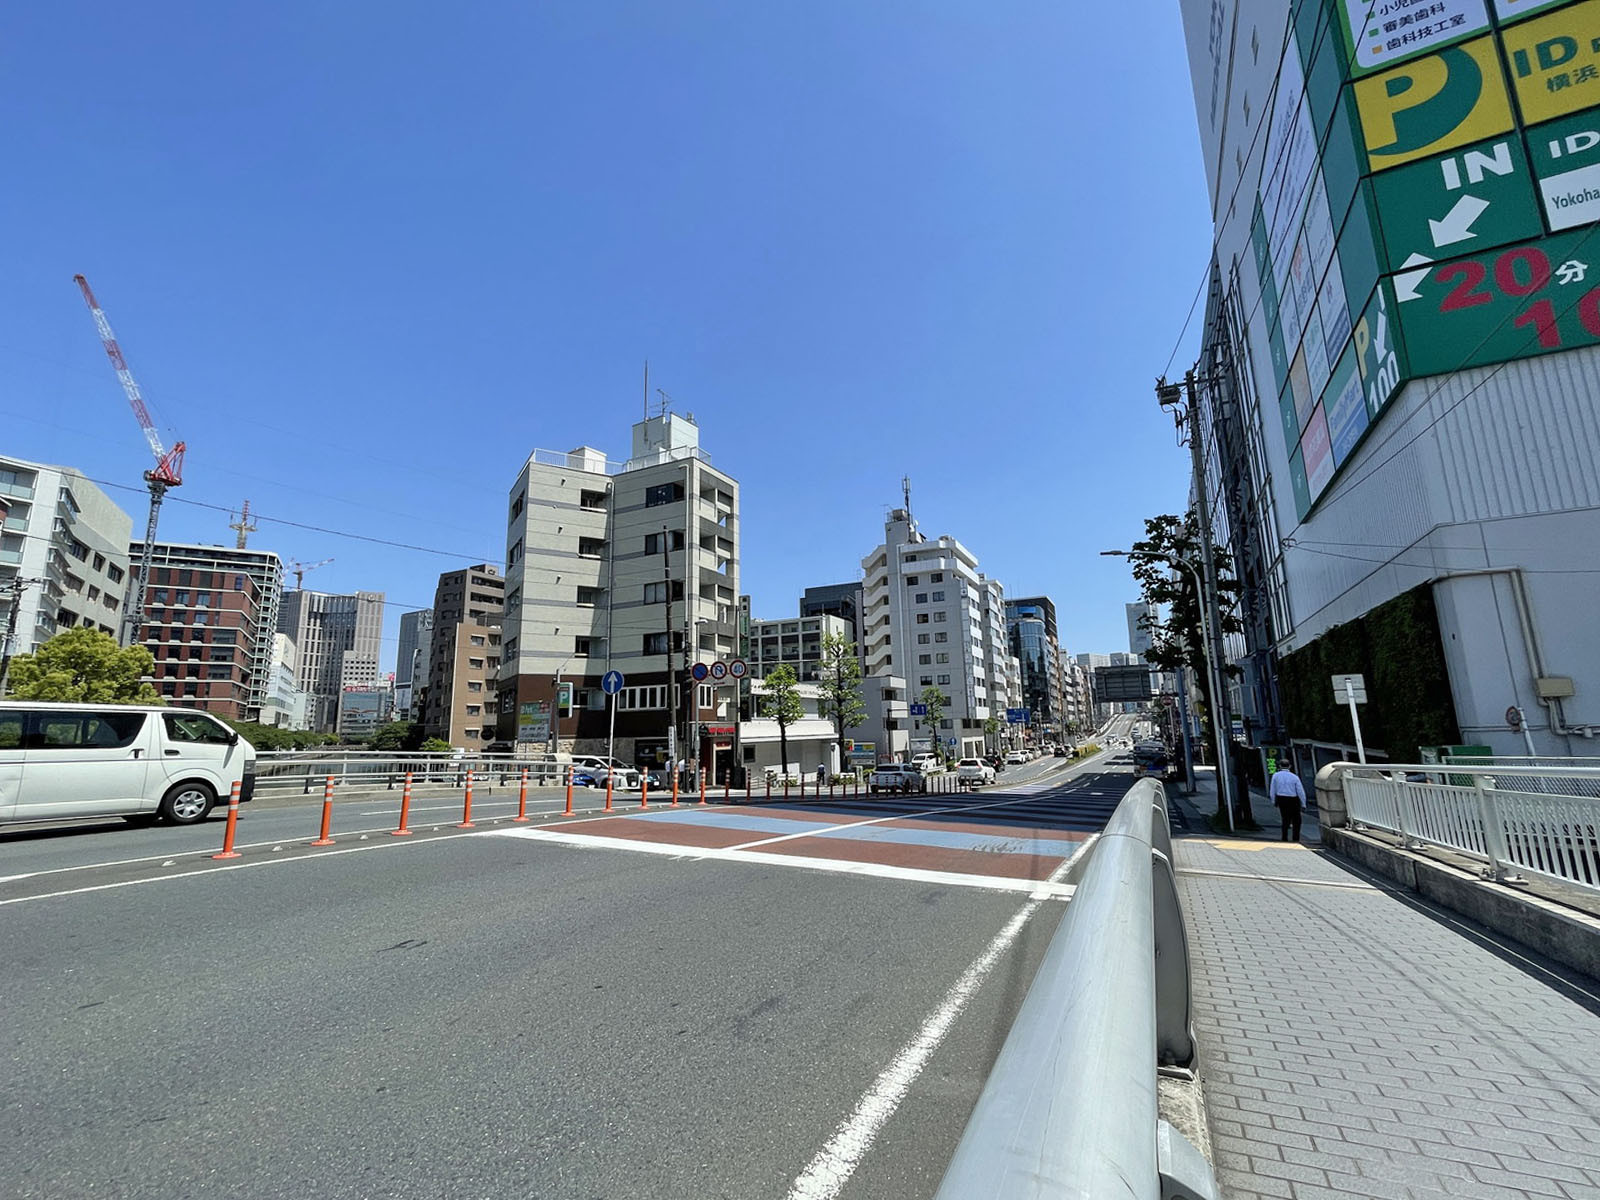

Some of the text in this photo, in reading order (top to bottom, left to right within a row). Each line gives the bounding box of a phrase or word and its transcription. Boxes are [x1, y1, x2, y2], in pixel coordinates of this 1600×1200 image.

[1383, 2, 1446, 33] 審美歯科
[1386, 14, 1466, 51] 歯科技工室
[1513, 36, 1578, 78] ID
[1354, 54, 1448, 150] P
[1549, 131, 1600, 158] ID
[1441, 142, 1514, 190] IN
[1369, 351, 1400, 413] 100
[560, 691, 568, 704] P
